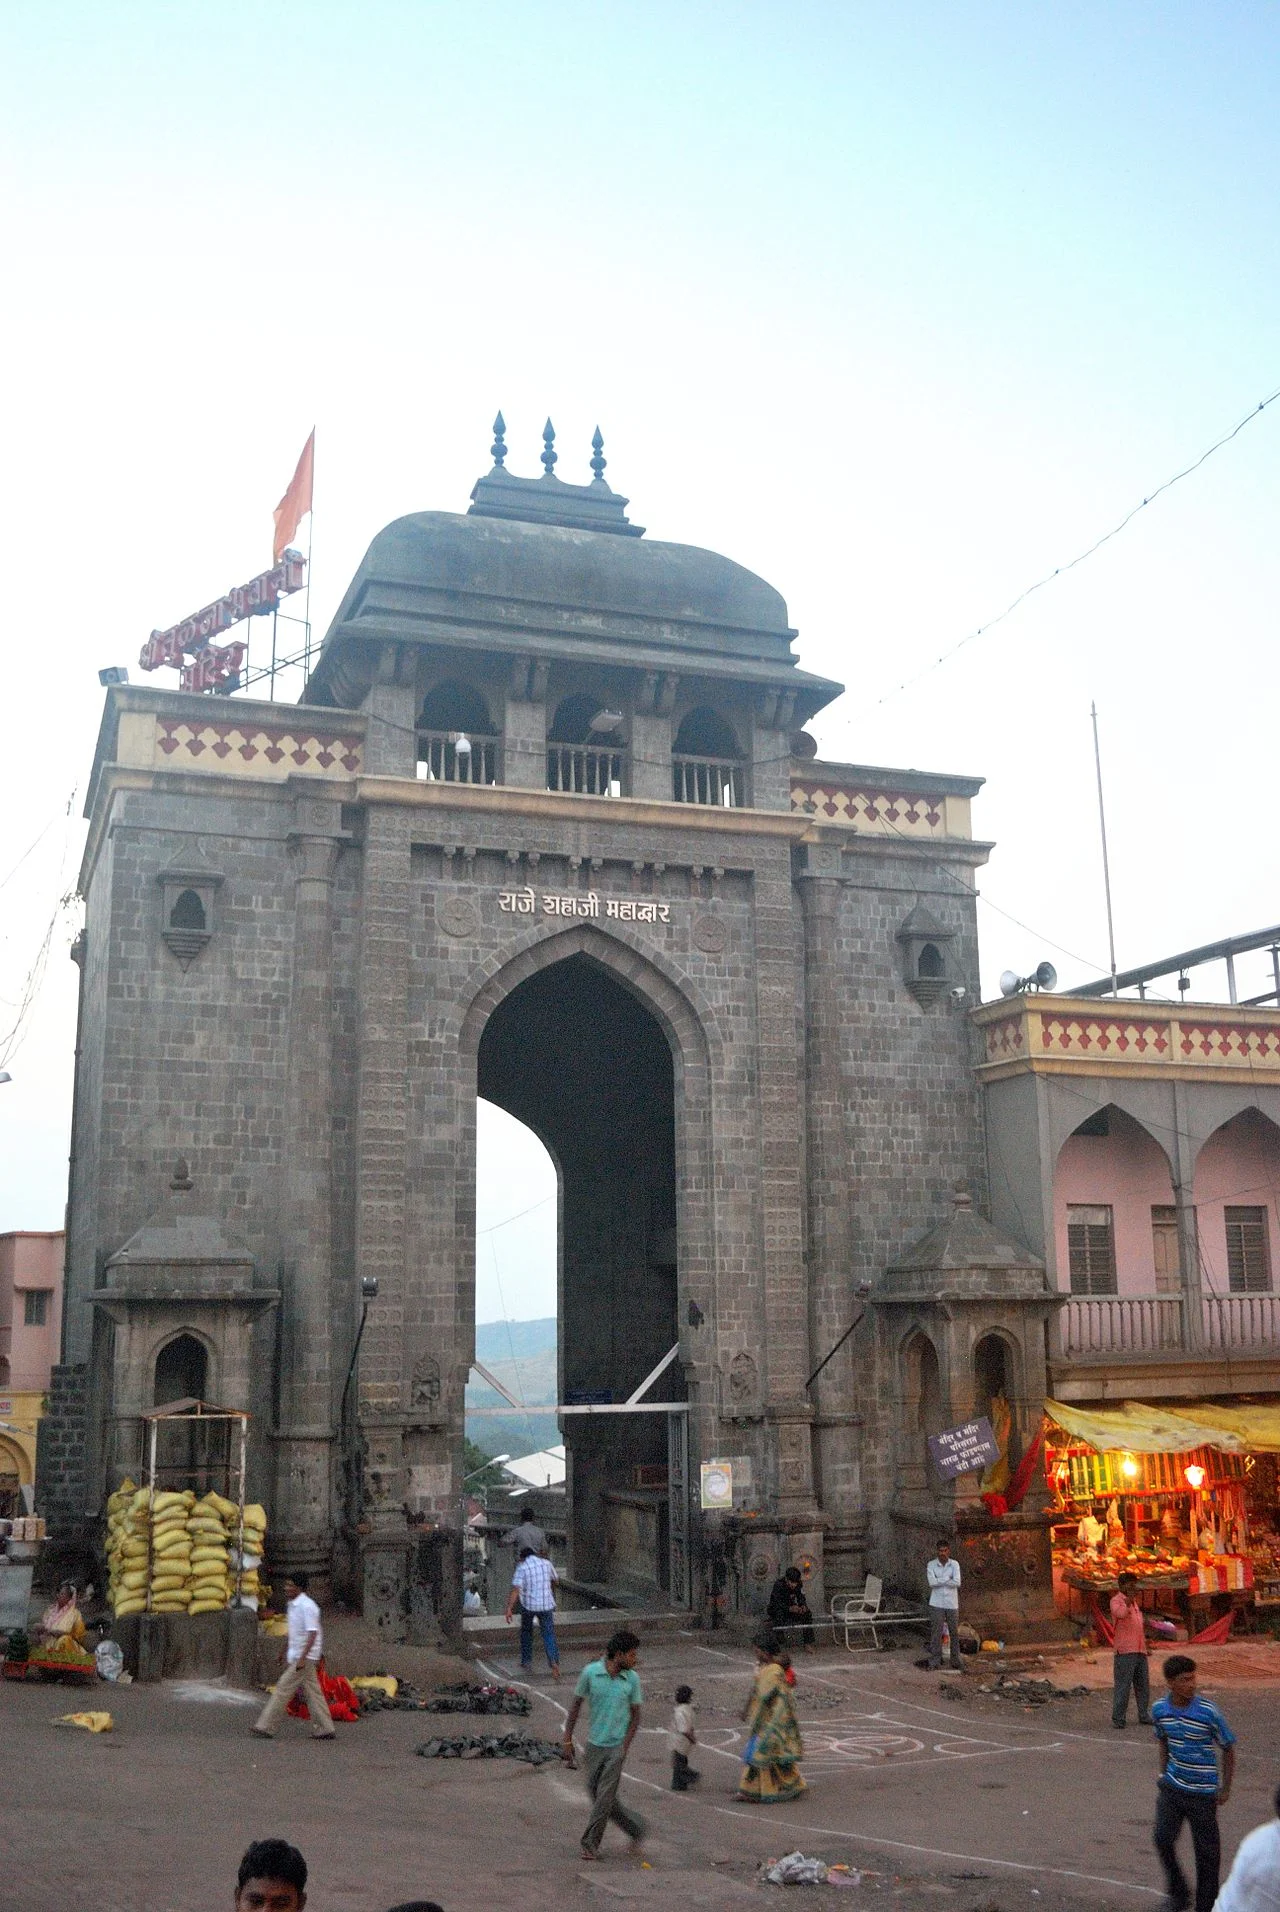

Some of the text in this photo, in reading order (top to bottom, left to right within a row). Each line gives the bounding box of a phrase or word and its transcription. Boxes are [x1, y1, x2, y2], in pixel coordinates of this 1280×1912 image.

[498, 887, 671, 923] राजे शहाजी महाद्वार
